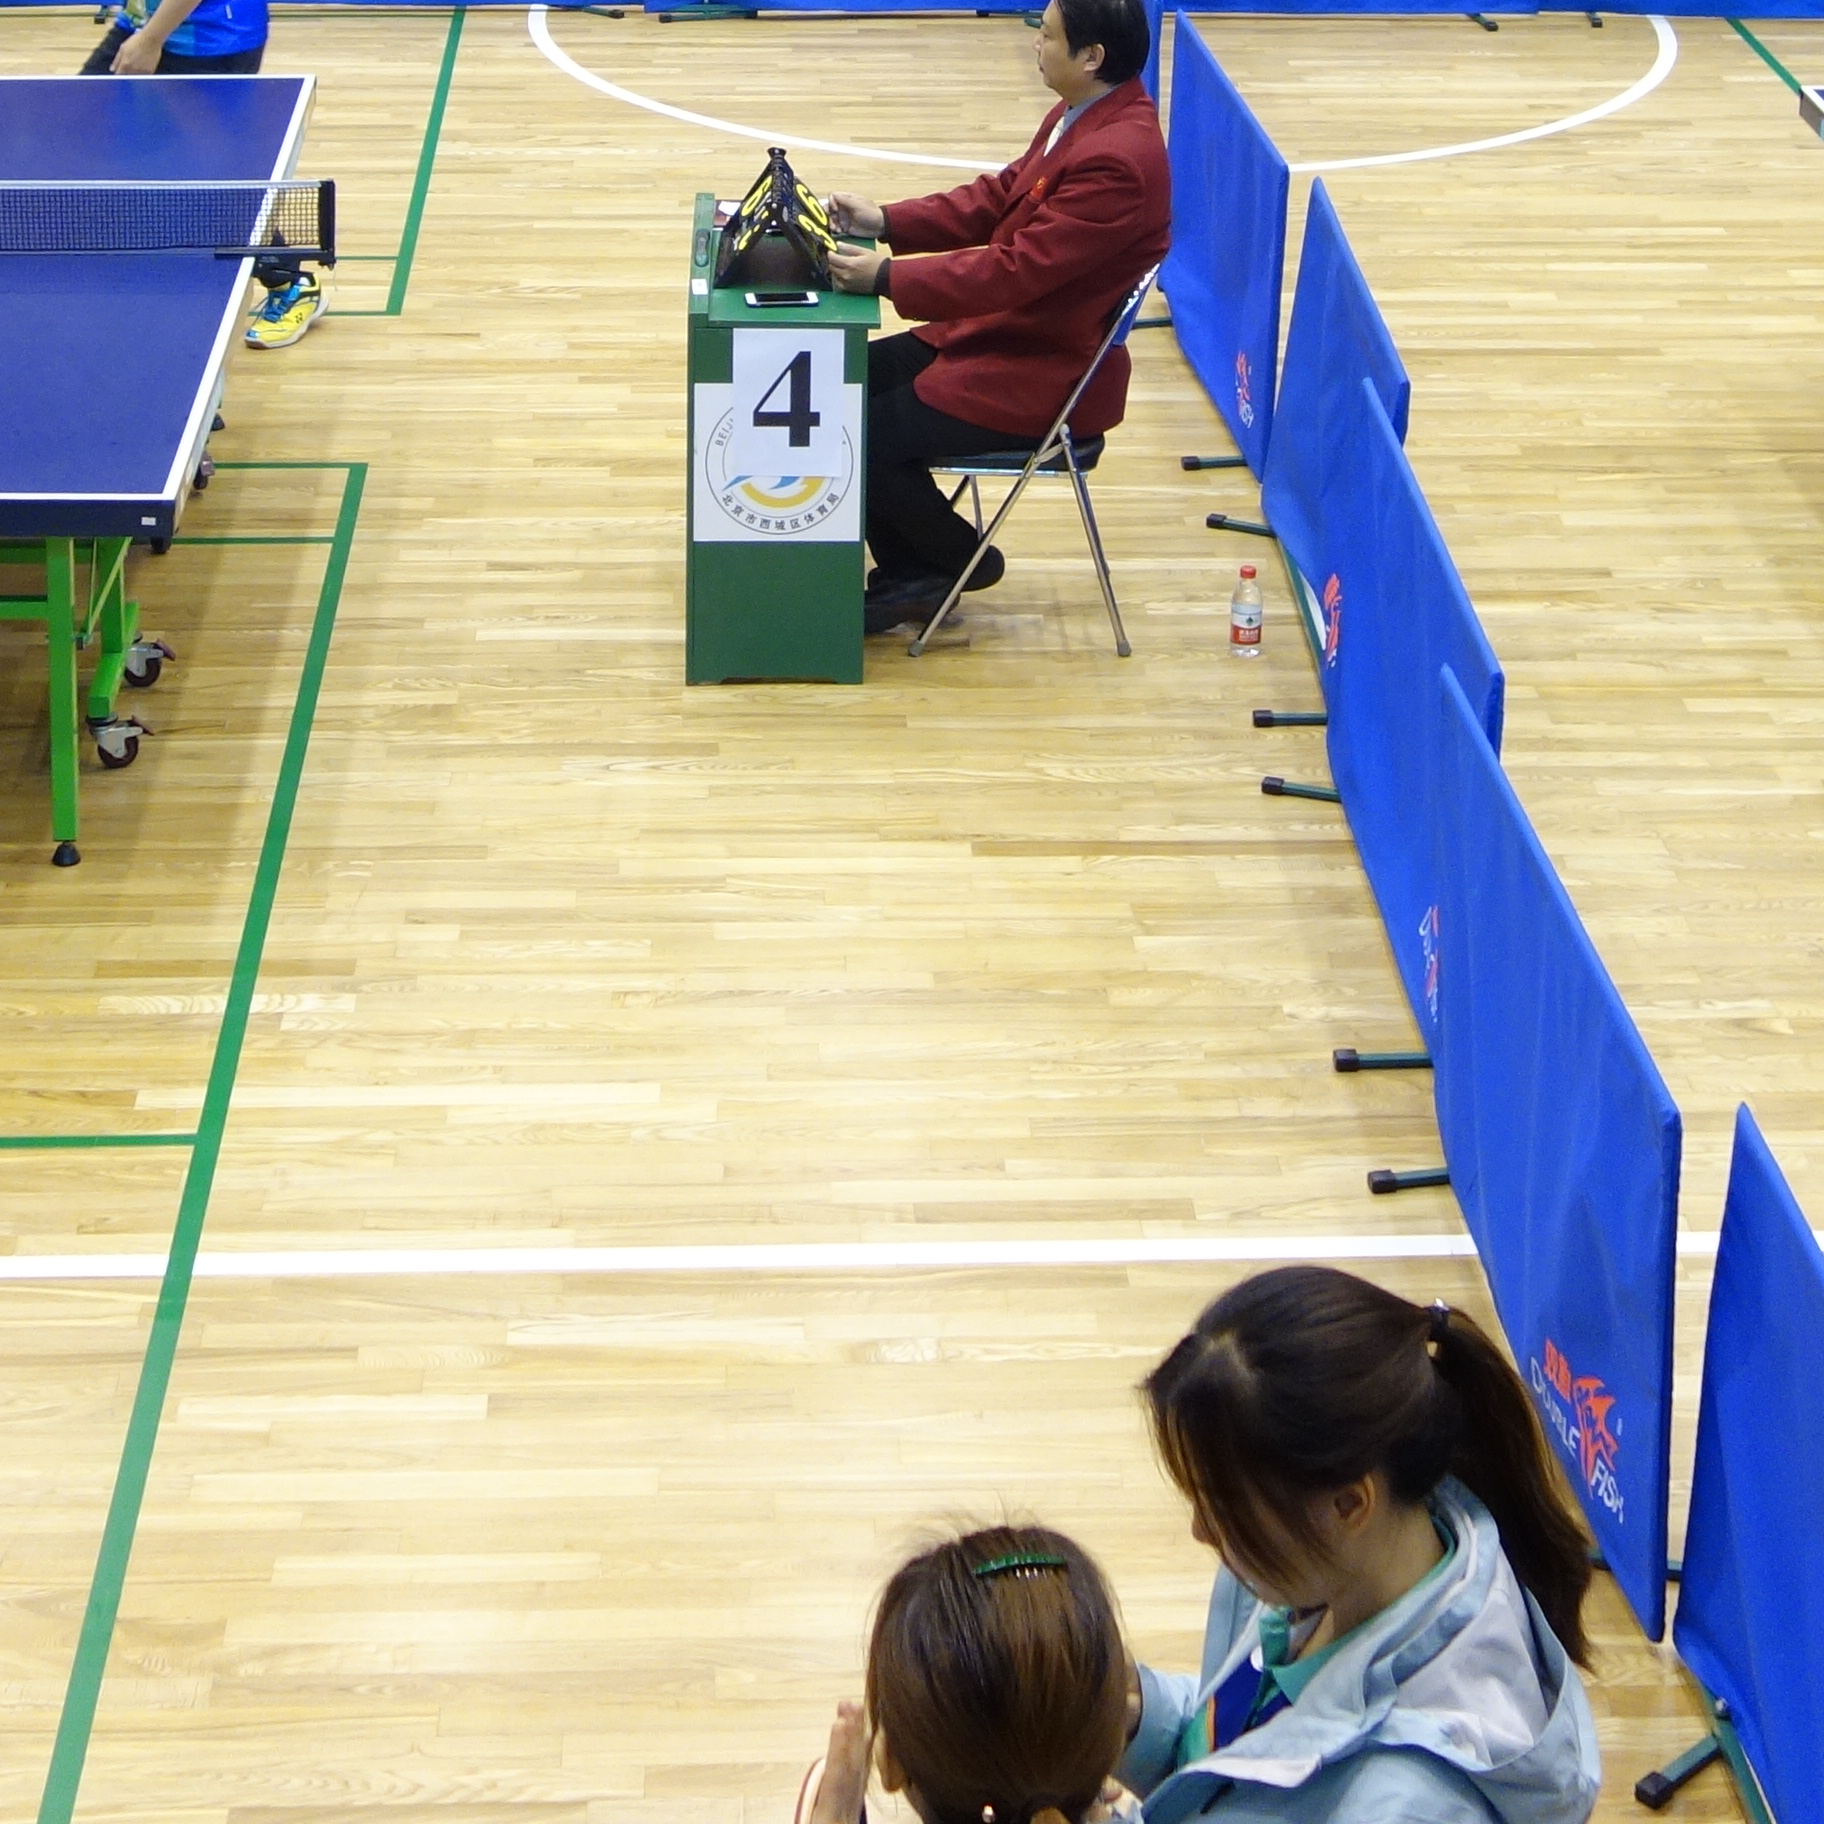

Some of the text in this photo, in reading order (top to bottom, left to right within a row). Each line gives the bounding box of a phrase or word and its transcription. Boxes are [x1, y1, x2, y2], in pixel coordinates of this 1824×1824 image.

[752, 349, 821, 448] 4
[721, 491, 840, 531] 北京市西城区体育局
[1529, 1356, 1625, 1525] DOUBLE FISH
